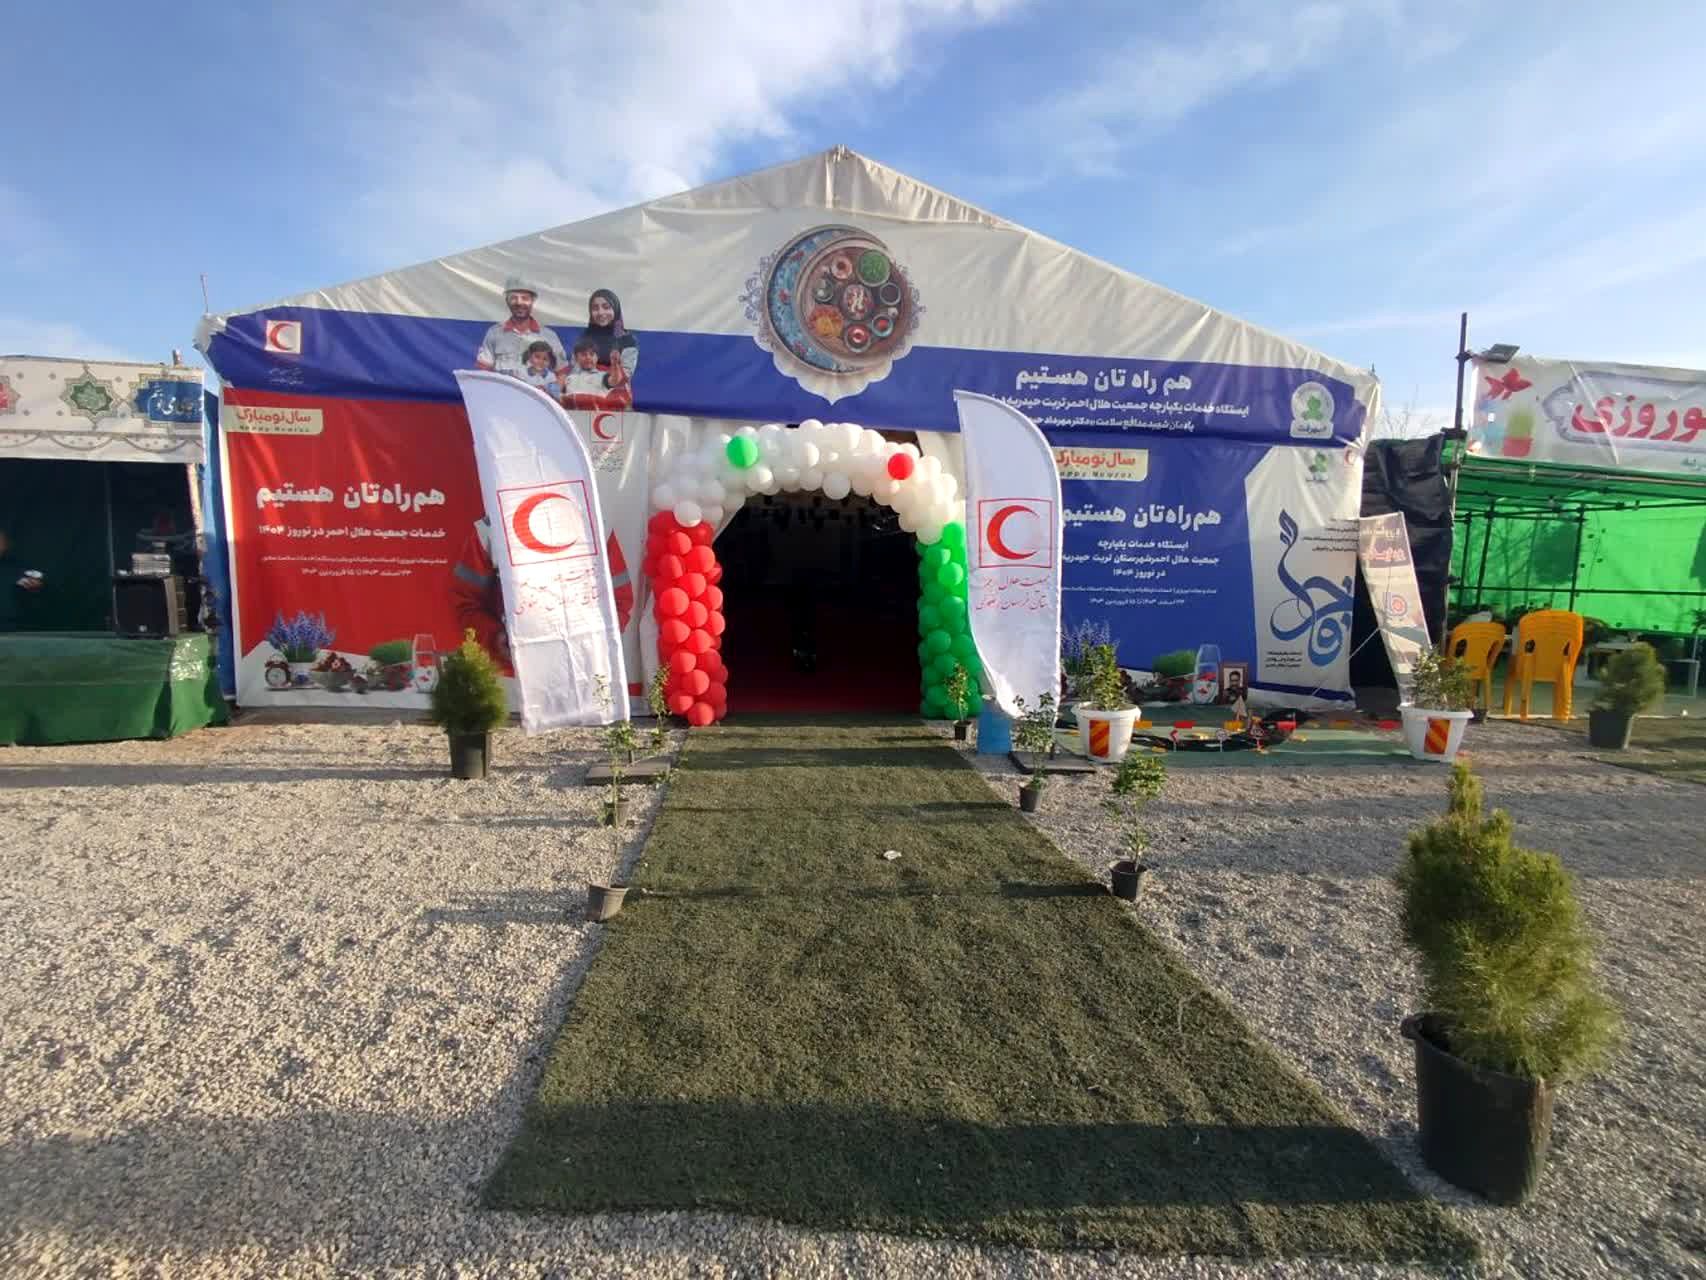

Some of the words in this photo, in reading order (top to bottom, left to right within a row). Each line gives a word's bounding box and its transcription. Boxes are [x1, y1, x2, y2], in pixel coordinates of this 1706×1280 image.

[1015, 366, 1088, 390] هستیم
[1094, 368, 1126, 392] تان
[1131, 370, 1157, 395] راه
[1163, 375, 1192, 396] هم
[1088, 399, 1111, 411] هلال
[256, 481, 335, 509] هستیم
[287, 525, 311, 538] نوروز
[325, 526, 349, 538] احمر
[350, 526, 371, 539] هلال
[372, 528, 408, 540] جمعیت
[409, 527, 446, 538] خدمات
